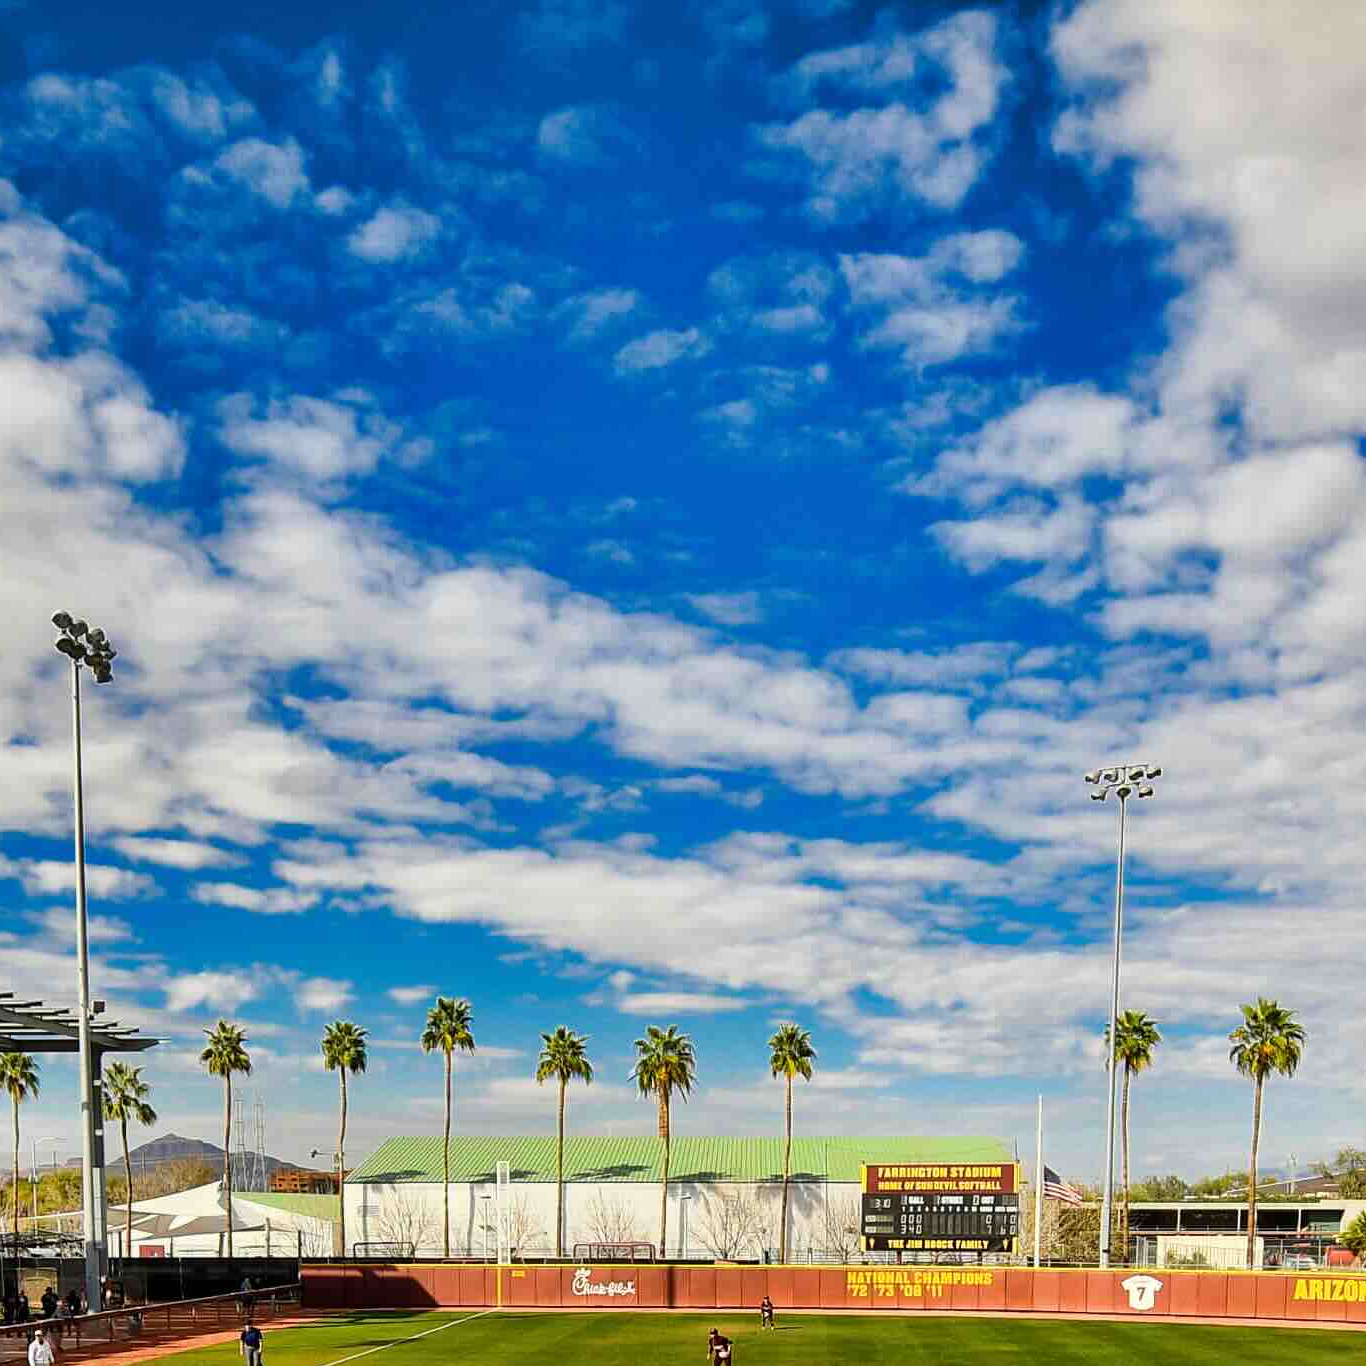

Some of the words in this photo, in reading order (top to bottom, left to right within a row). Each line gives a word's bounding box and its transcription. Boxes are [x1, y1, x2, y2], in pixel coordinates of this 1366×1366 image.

[878, 1167, 948, 1178] FARRINGTON
[950, 1167, 1002, 1178] STADIUM
[958, 1181, 1002, 1190] SOFTBALL
[888, 1239, 904, 1249] THE
[955, 1239, 989, 1249] FAMILY
[847, 1271, 911, 1284] NATIONAL
[914, 1272, 994, 1285] CHAMPIONS
[847, 1284, 868, 1297] '72
[873, 1284, 895, 1297] '73
[1137, 1287, 1147, 1302] 7
